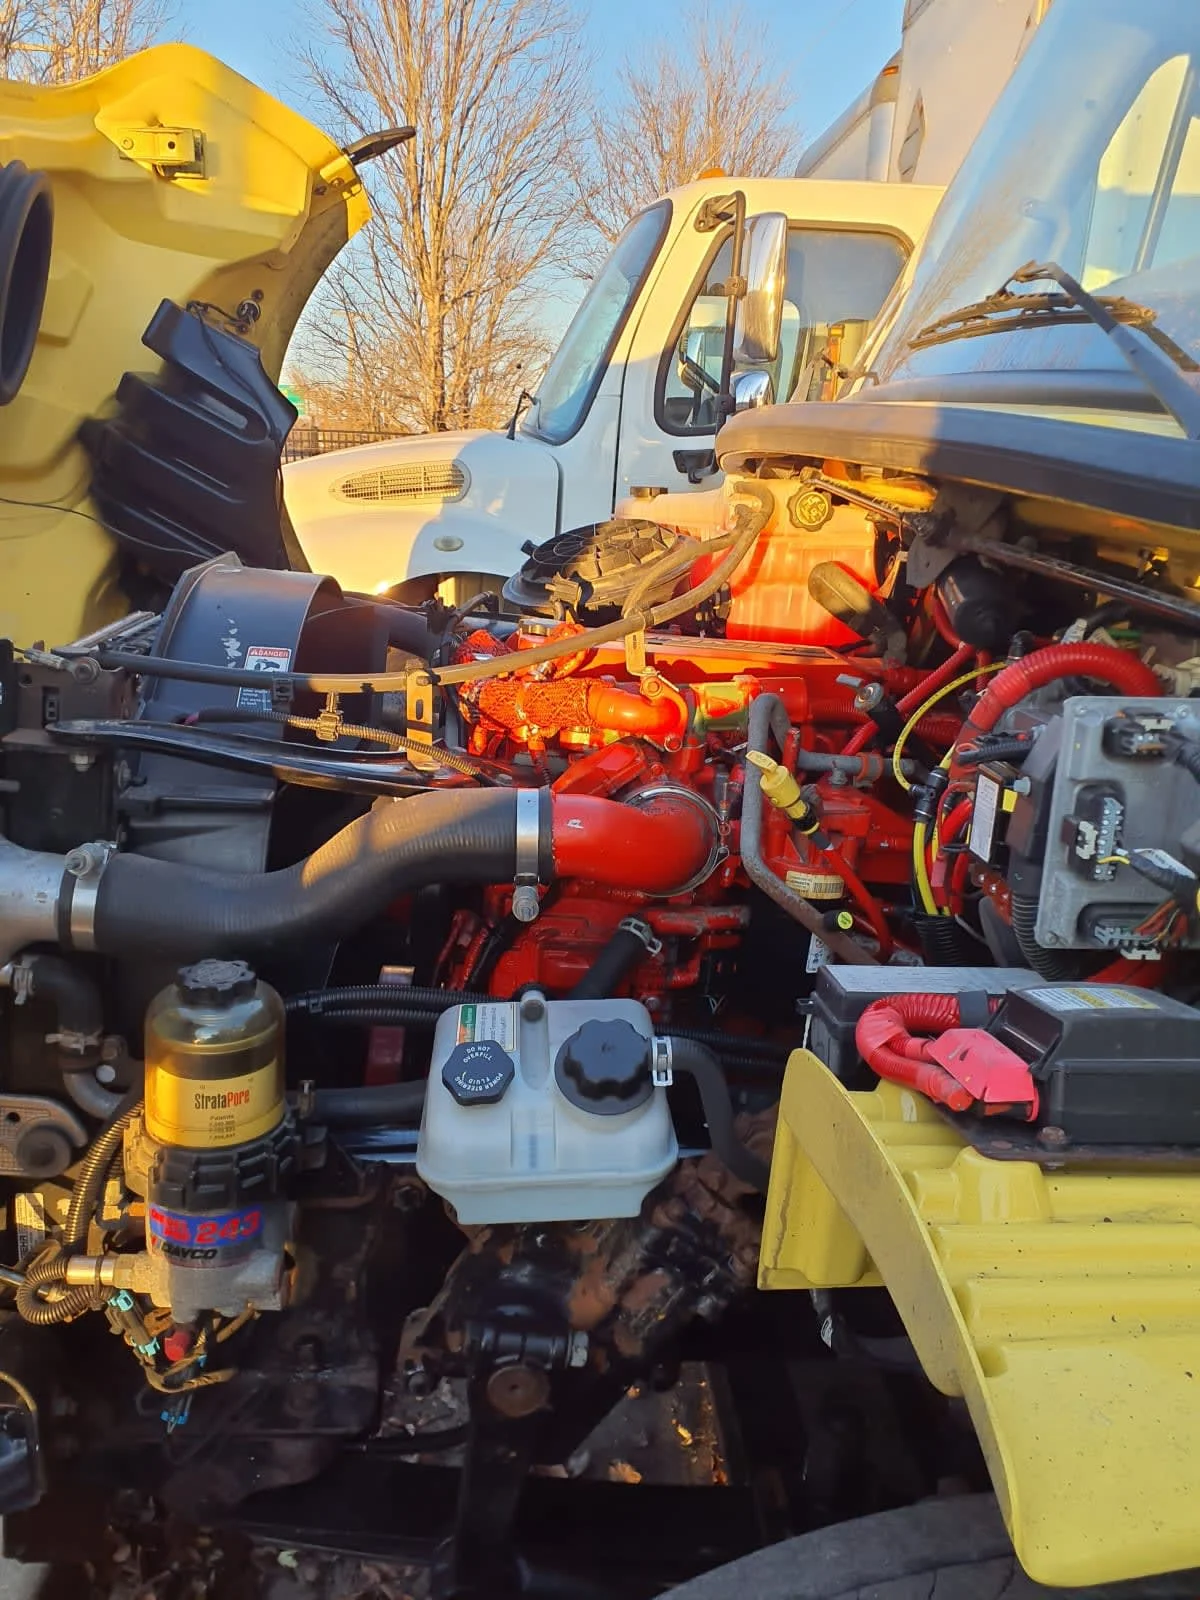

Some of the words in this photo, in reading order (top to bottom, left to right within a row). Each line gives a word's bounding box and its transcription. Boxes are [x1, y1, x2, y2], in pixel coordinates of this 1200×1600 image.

[463, 1052, 492, 1063] OVERFILL
[466, 1046, 475, 1054] DO
[455, 1076, 483, 1091] STEERING
[469, 1077, 490, 1085] FLUID
[485, 1072, 503, 1089] POWER
[194, 1088, 250, 1110] StrataPore
[195, 1210, 260, 1244] 243
